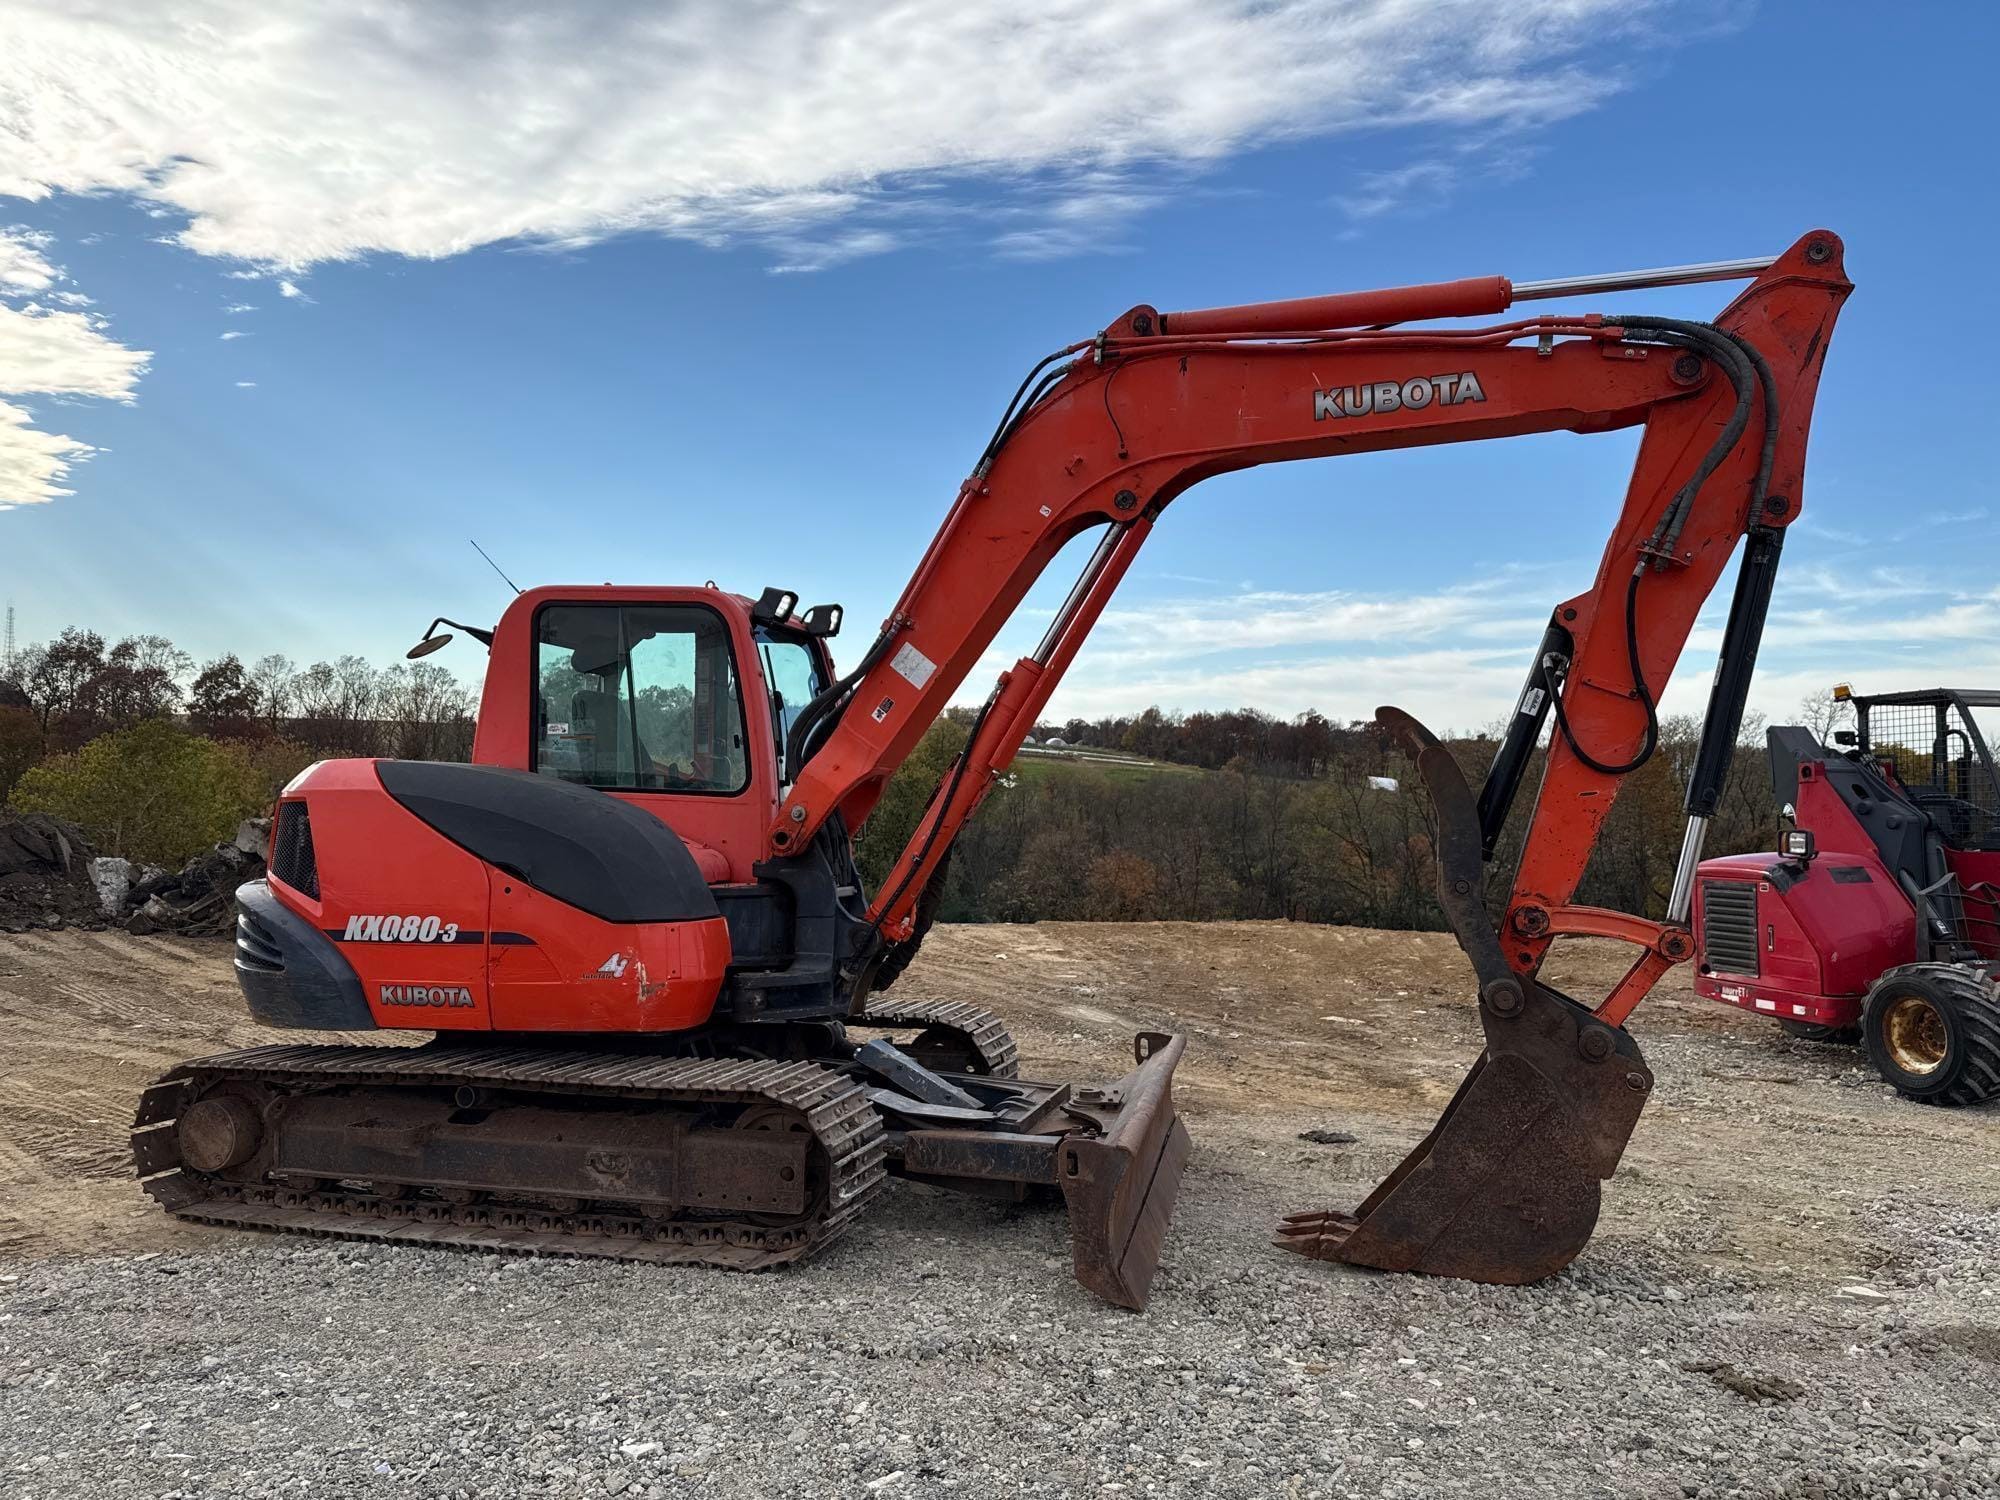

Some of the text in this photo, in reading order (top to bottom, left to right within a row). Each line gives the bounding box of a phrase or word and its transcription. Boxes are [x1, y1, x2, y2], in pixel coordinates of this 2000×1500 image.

[1314, 372, 1486, 420] KUBOTA
[343, 915, 459, 943] KX080-3
[380, 984, 475, 1008] KUBOTA
